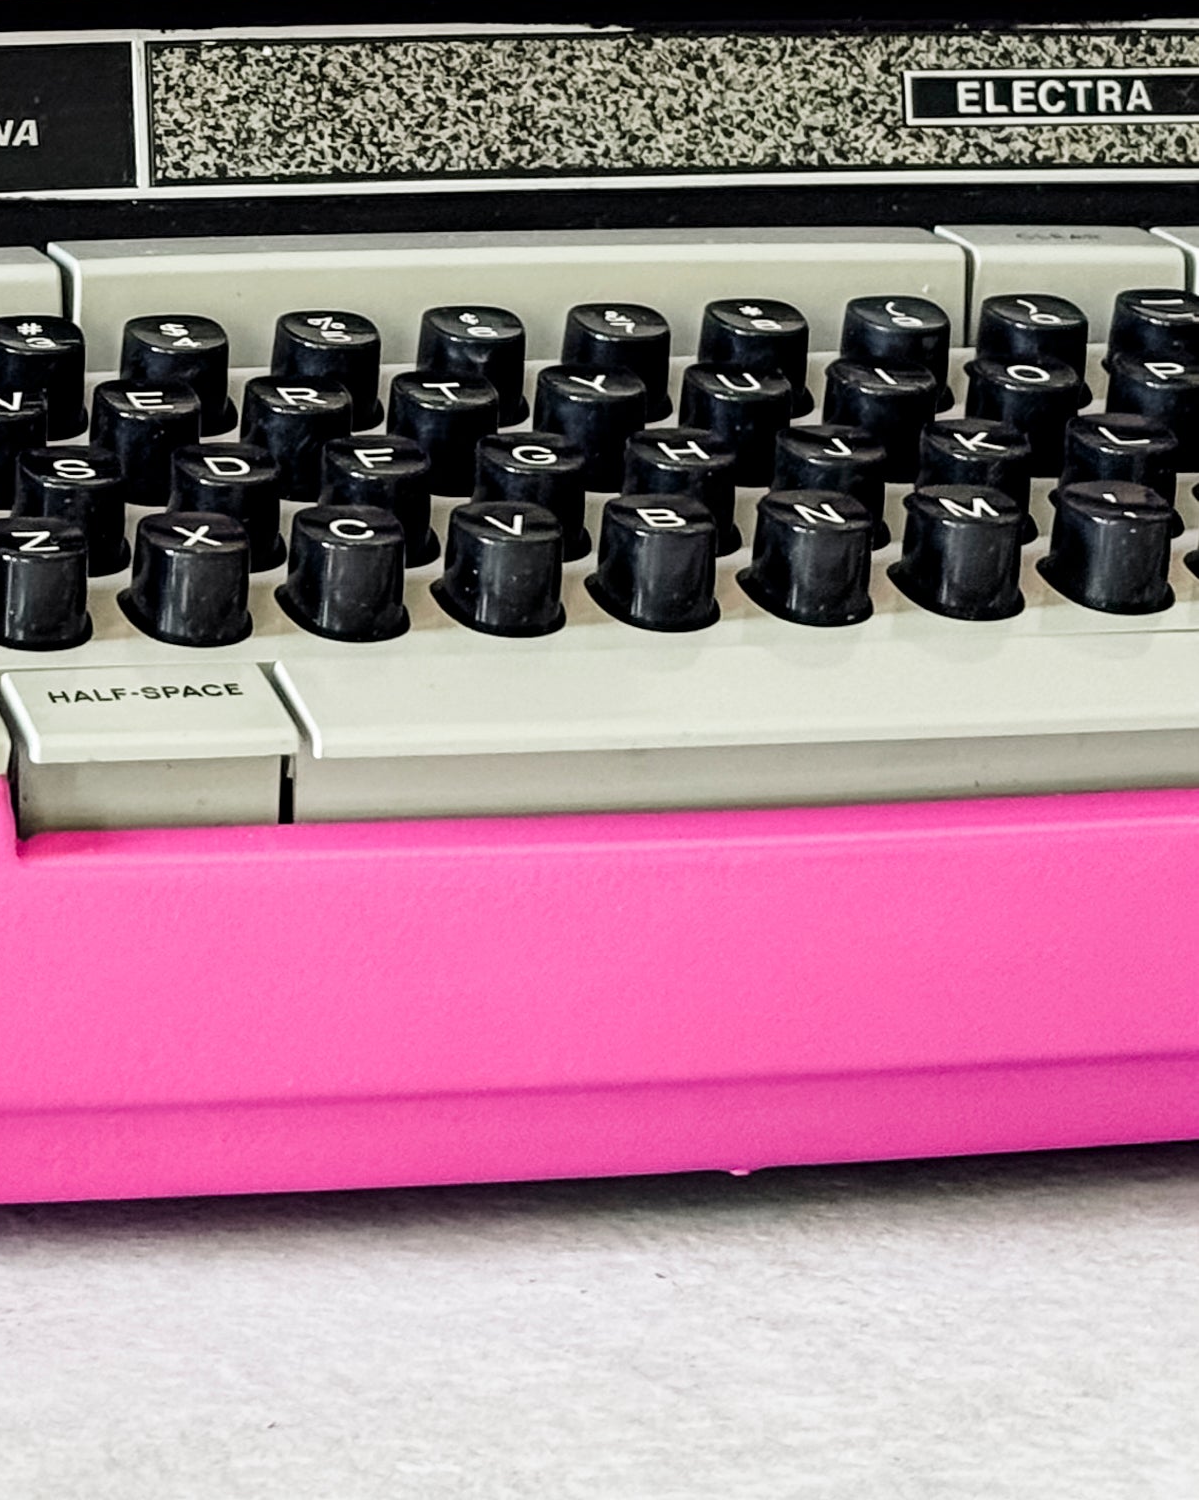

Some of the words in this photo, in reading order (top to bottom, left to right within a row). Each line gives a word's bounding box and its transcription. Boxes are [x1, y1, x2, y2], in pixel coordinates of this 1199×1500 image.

[956, 79, 1153, 114] ELECTRA
[1145, 362, 1184, 380] P
[423, 382, 460, 401] T
[570, 375, 607, 393] Y
[717, 373, 761, 391] U
[126, 391, 173, 410] E
[276, 387, 327, 405] R
[954, 432, 1007, 451] K
[1099, 427, 1149, 445] L
[512, 446, 557, 465] G
[657, 441, 709, 461] H
[823, 439, 852, 456] J
[203, 457, 250, 476] D
[354, 448, 394, 468] F
[53, 459, 96, 479] S
[794, 504, 846, 524] N
[939, 498, 999, 518] M
[484, 515, 523, 535] V
[637, 509, 686, 528] B
[172, 526, 222, 547] X
[329, 519, 375, 539] C
[11, 531, 60, 552] Z
[48, 681, 244, 704] HALF-SPACE
